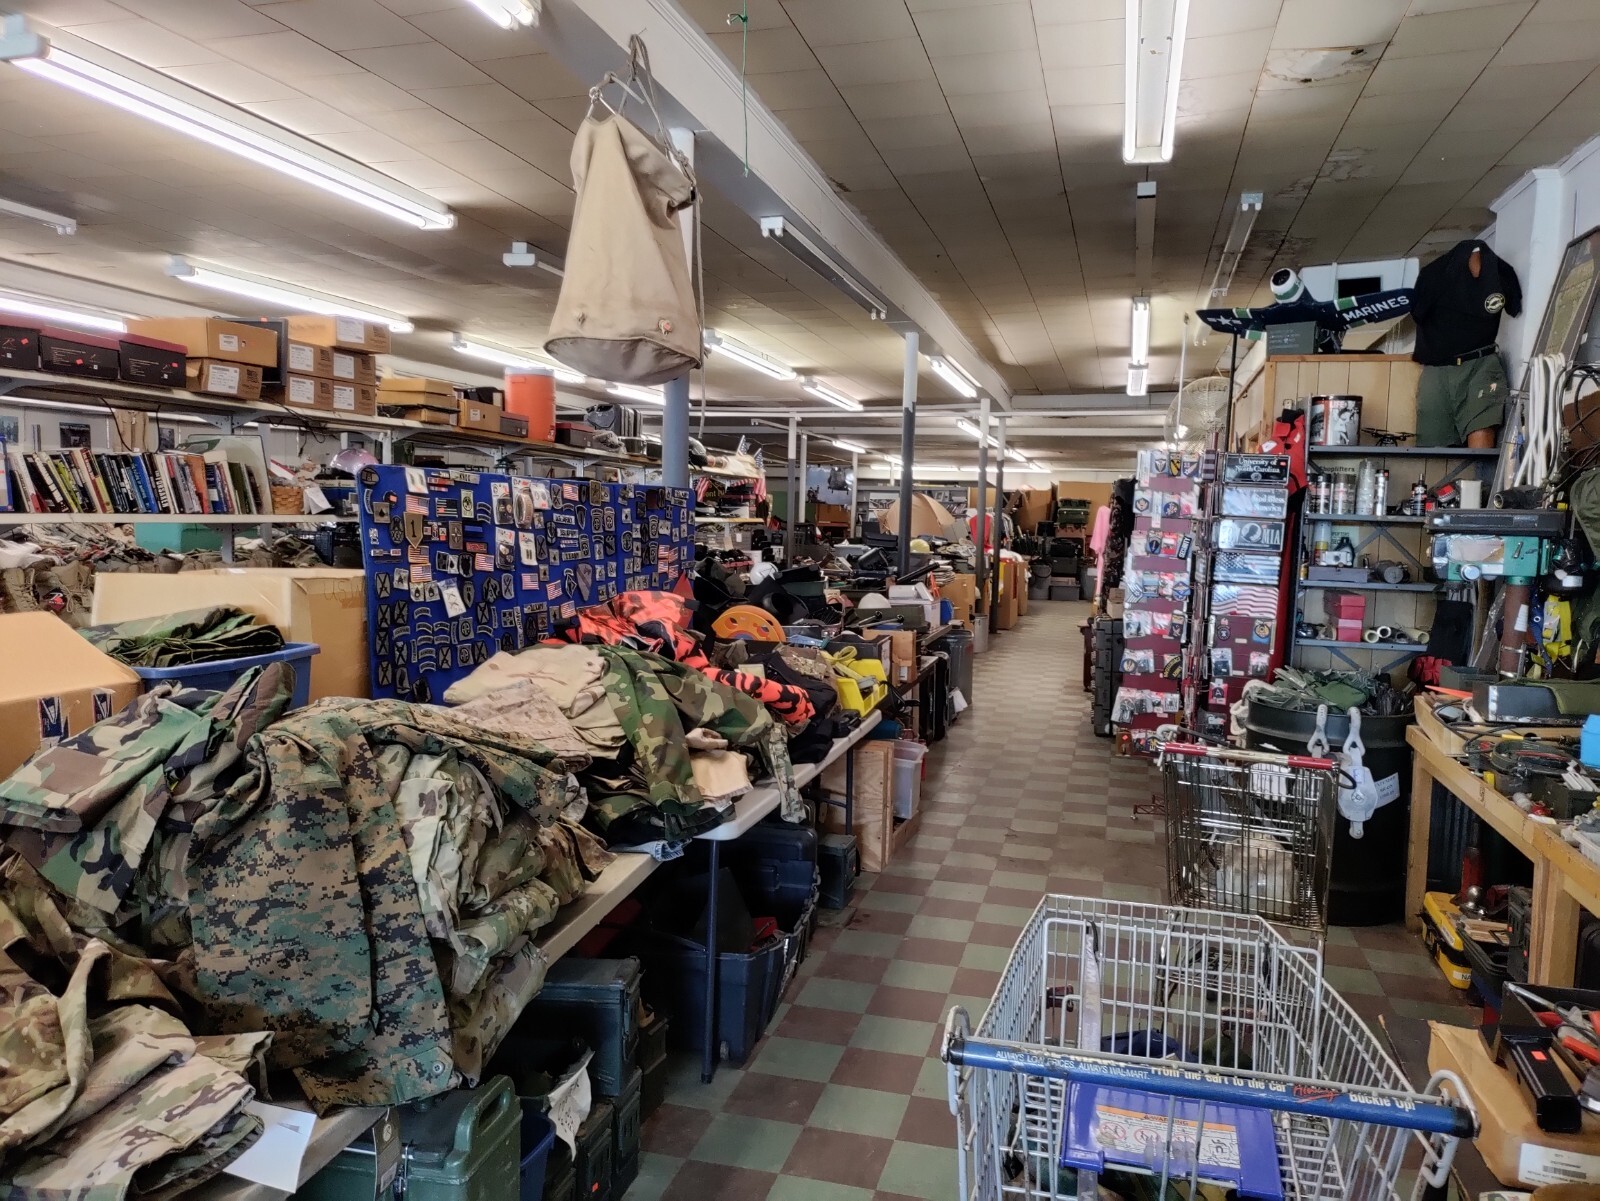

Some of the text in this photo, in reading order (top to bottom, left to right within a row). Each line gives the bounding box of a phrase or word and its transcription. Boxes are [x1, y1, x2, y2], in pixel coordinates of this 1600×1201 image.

[1342, 295, 1410, 321] MARINES
[1331, 400, 1345, 409] LIFE
[1238, 457, 1269, 466] University
[410, 519, 417, 538] 1
[1261, 528, 1281, 545] MIA
[1178, 537, 1192, 559] SECURITY
[1078, 1062, 1109, 1074] ALWAYS
